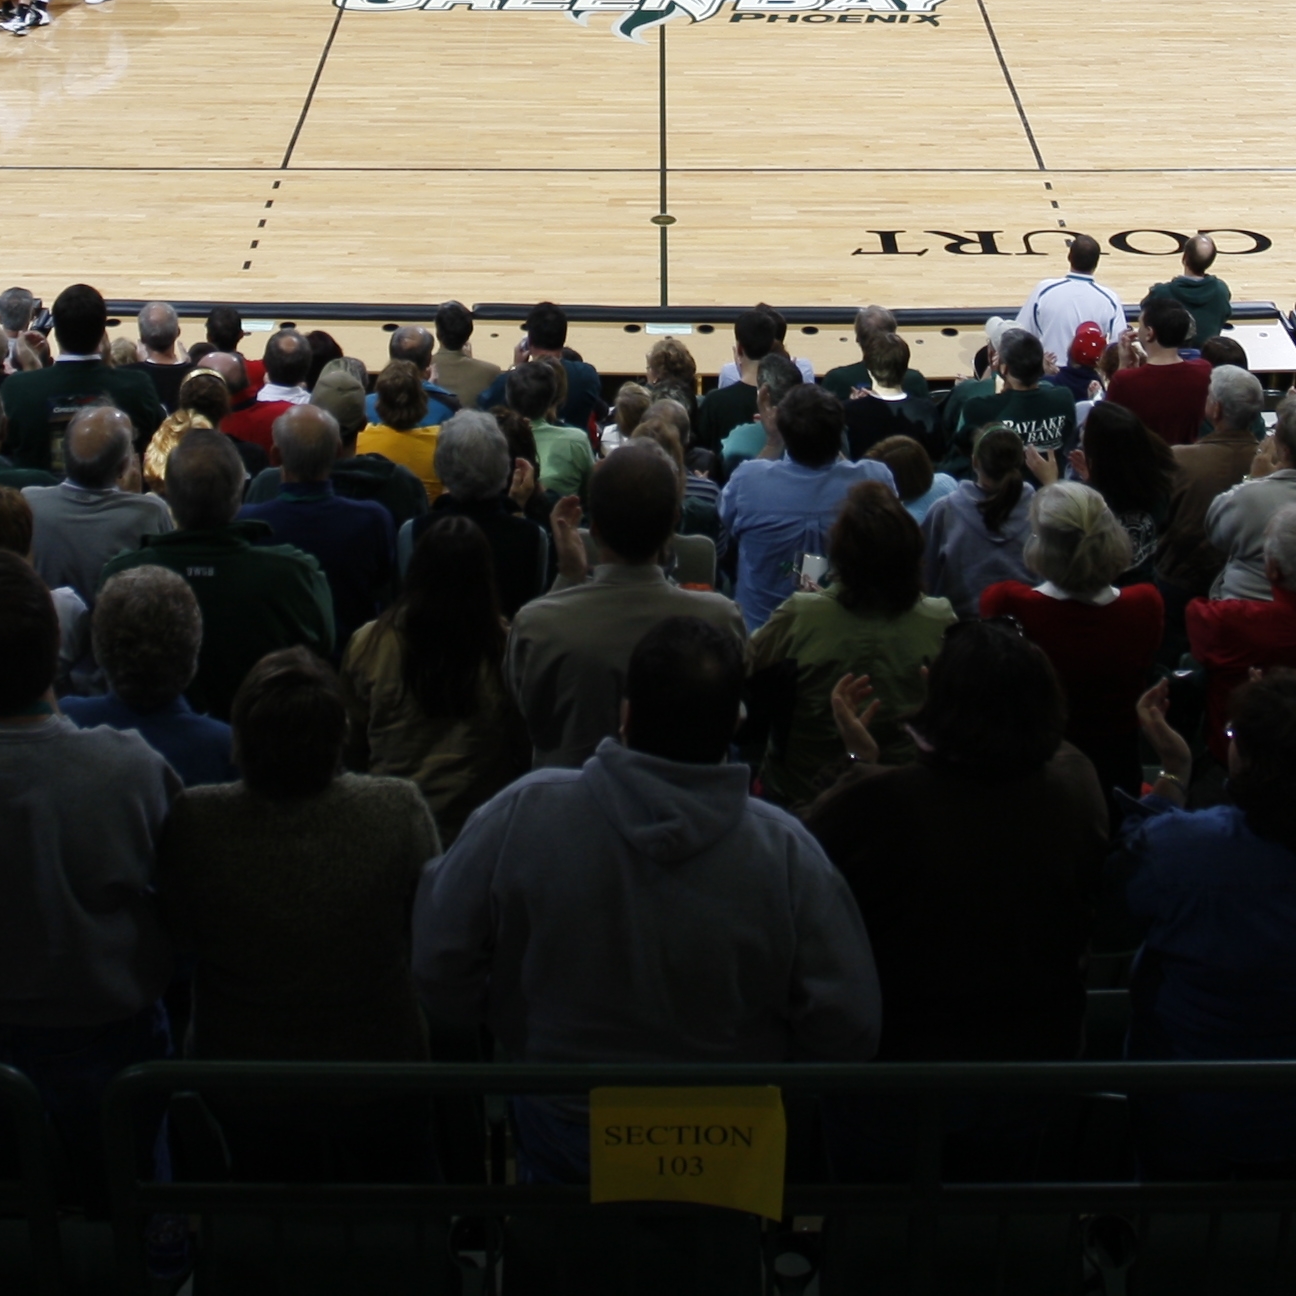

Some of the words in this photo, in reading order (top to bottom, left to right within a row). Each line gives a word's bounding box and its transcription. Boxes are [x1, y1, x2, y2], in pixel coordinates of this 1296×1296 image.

[727, 13, 943, 27] PHOENIX
[1026, 429, 1064, 444] BANK
[604, 1125, 753, 1147] SECTION
[657, 1156, 704, 1176] 103
